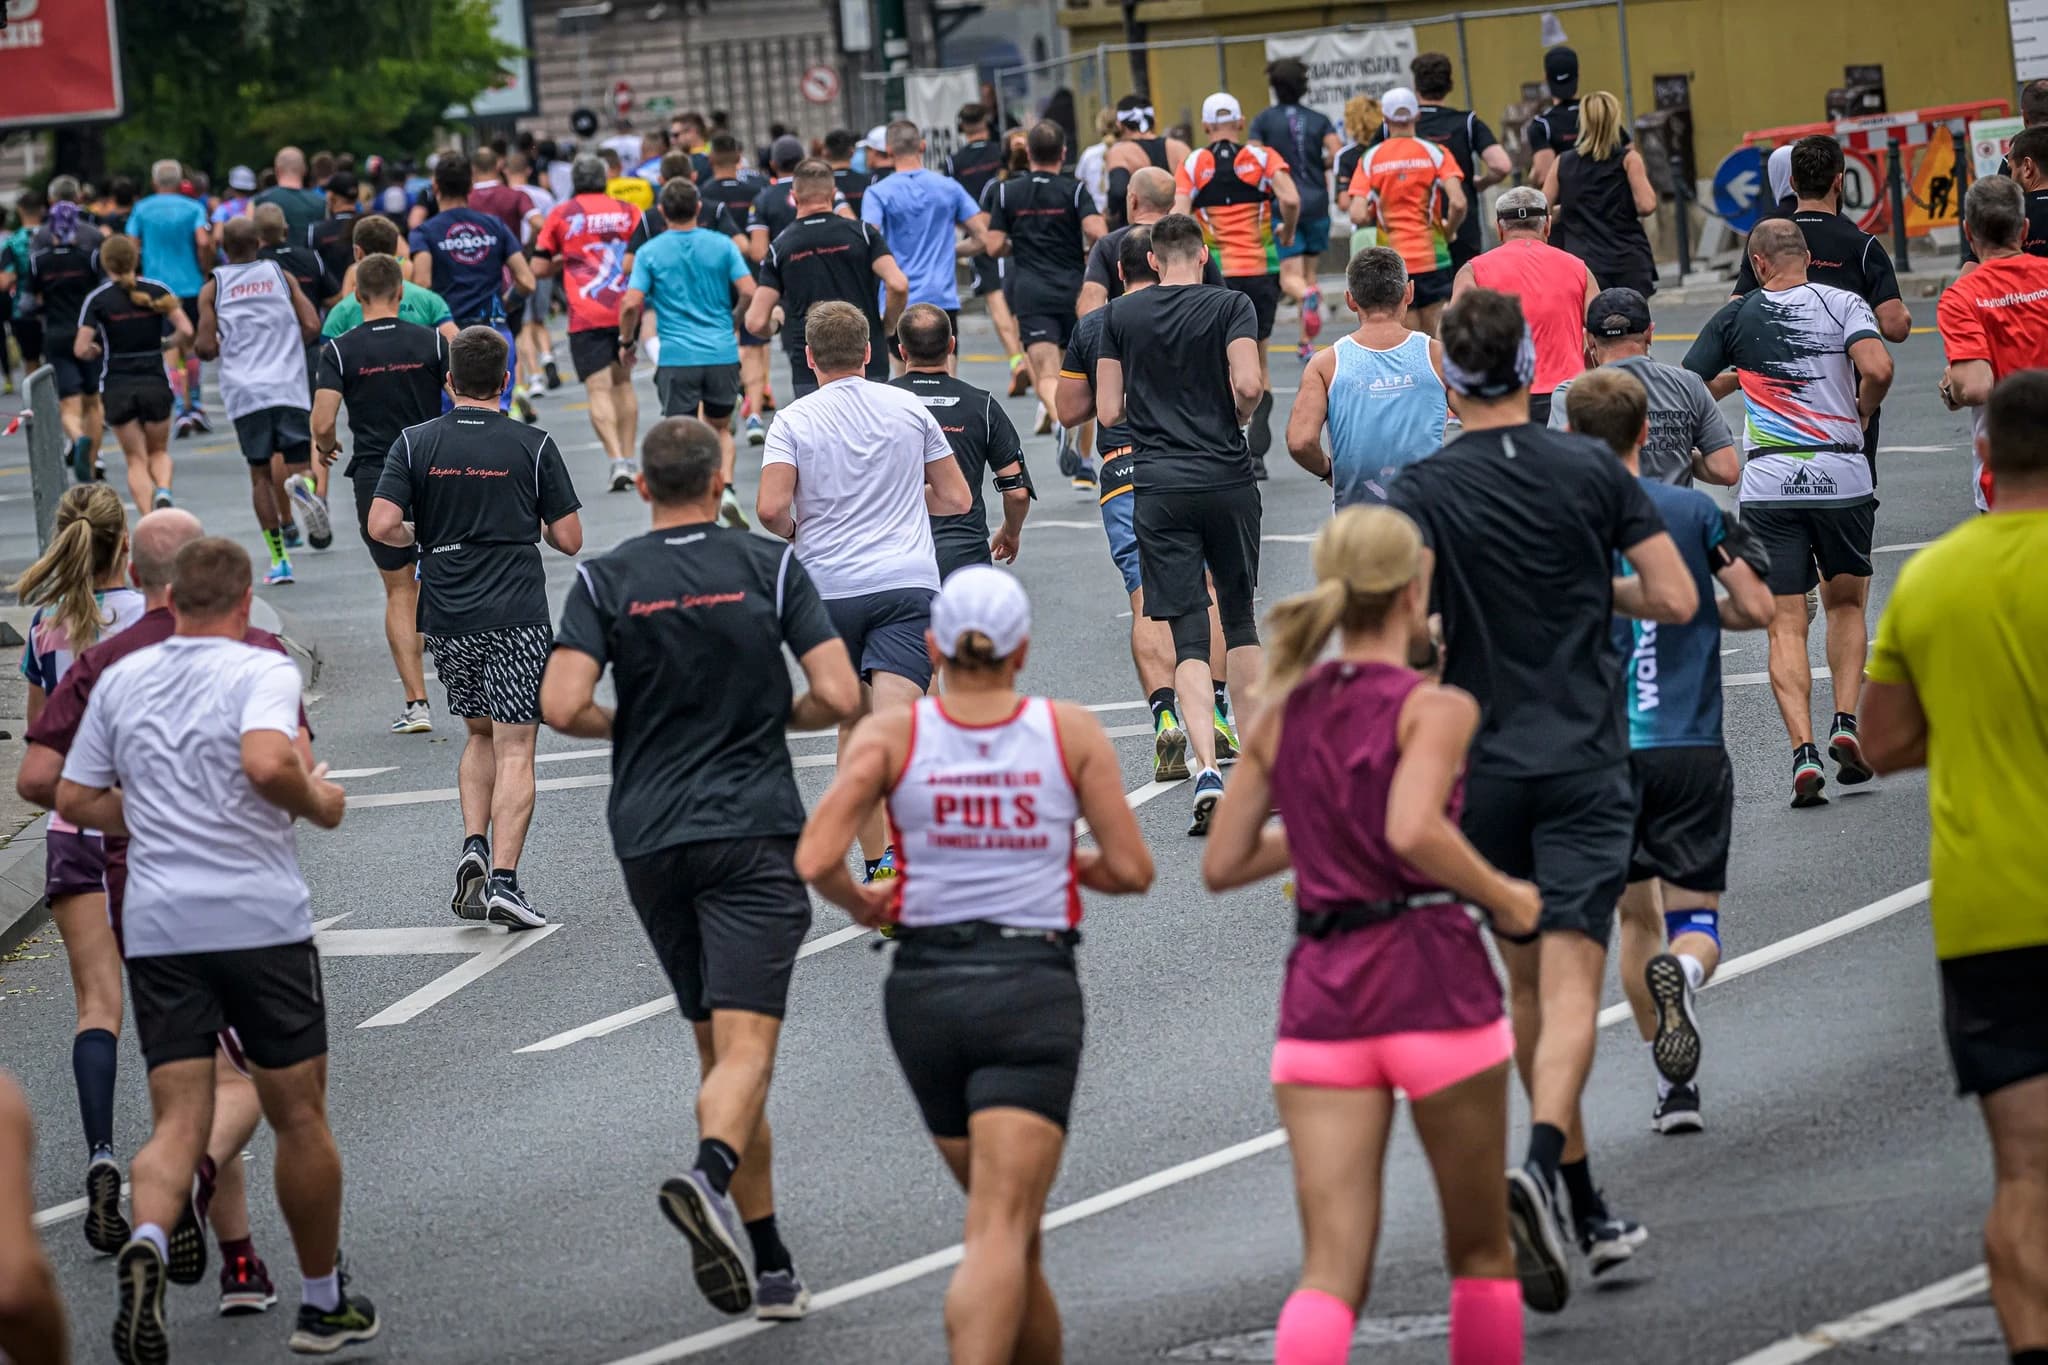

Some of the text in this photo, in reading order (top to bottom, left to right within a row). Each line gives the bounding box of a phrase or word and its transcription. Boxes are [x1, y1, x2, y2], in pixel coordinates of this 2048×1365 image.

[1374, 373, 1414, 388] ALFA
[1812, 485, 1834, 494] TRAIL
[934, 793, 1039, 830] PULS
